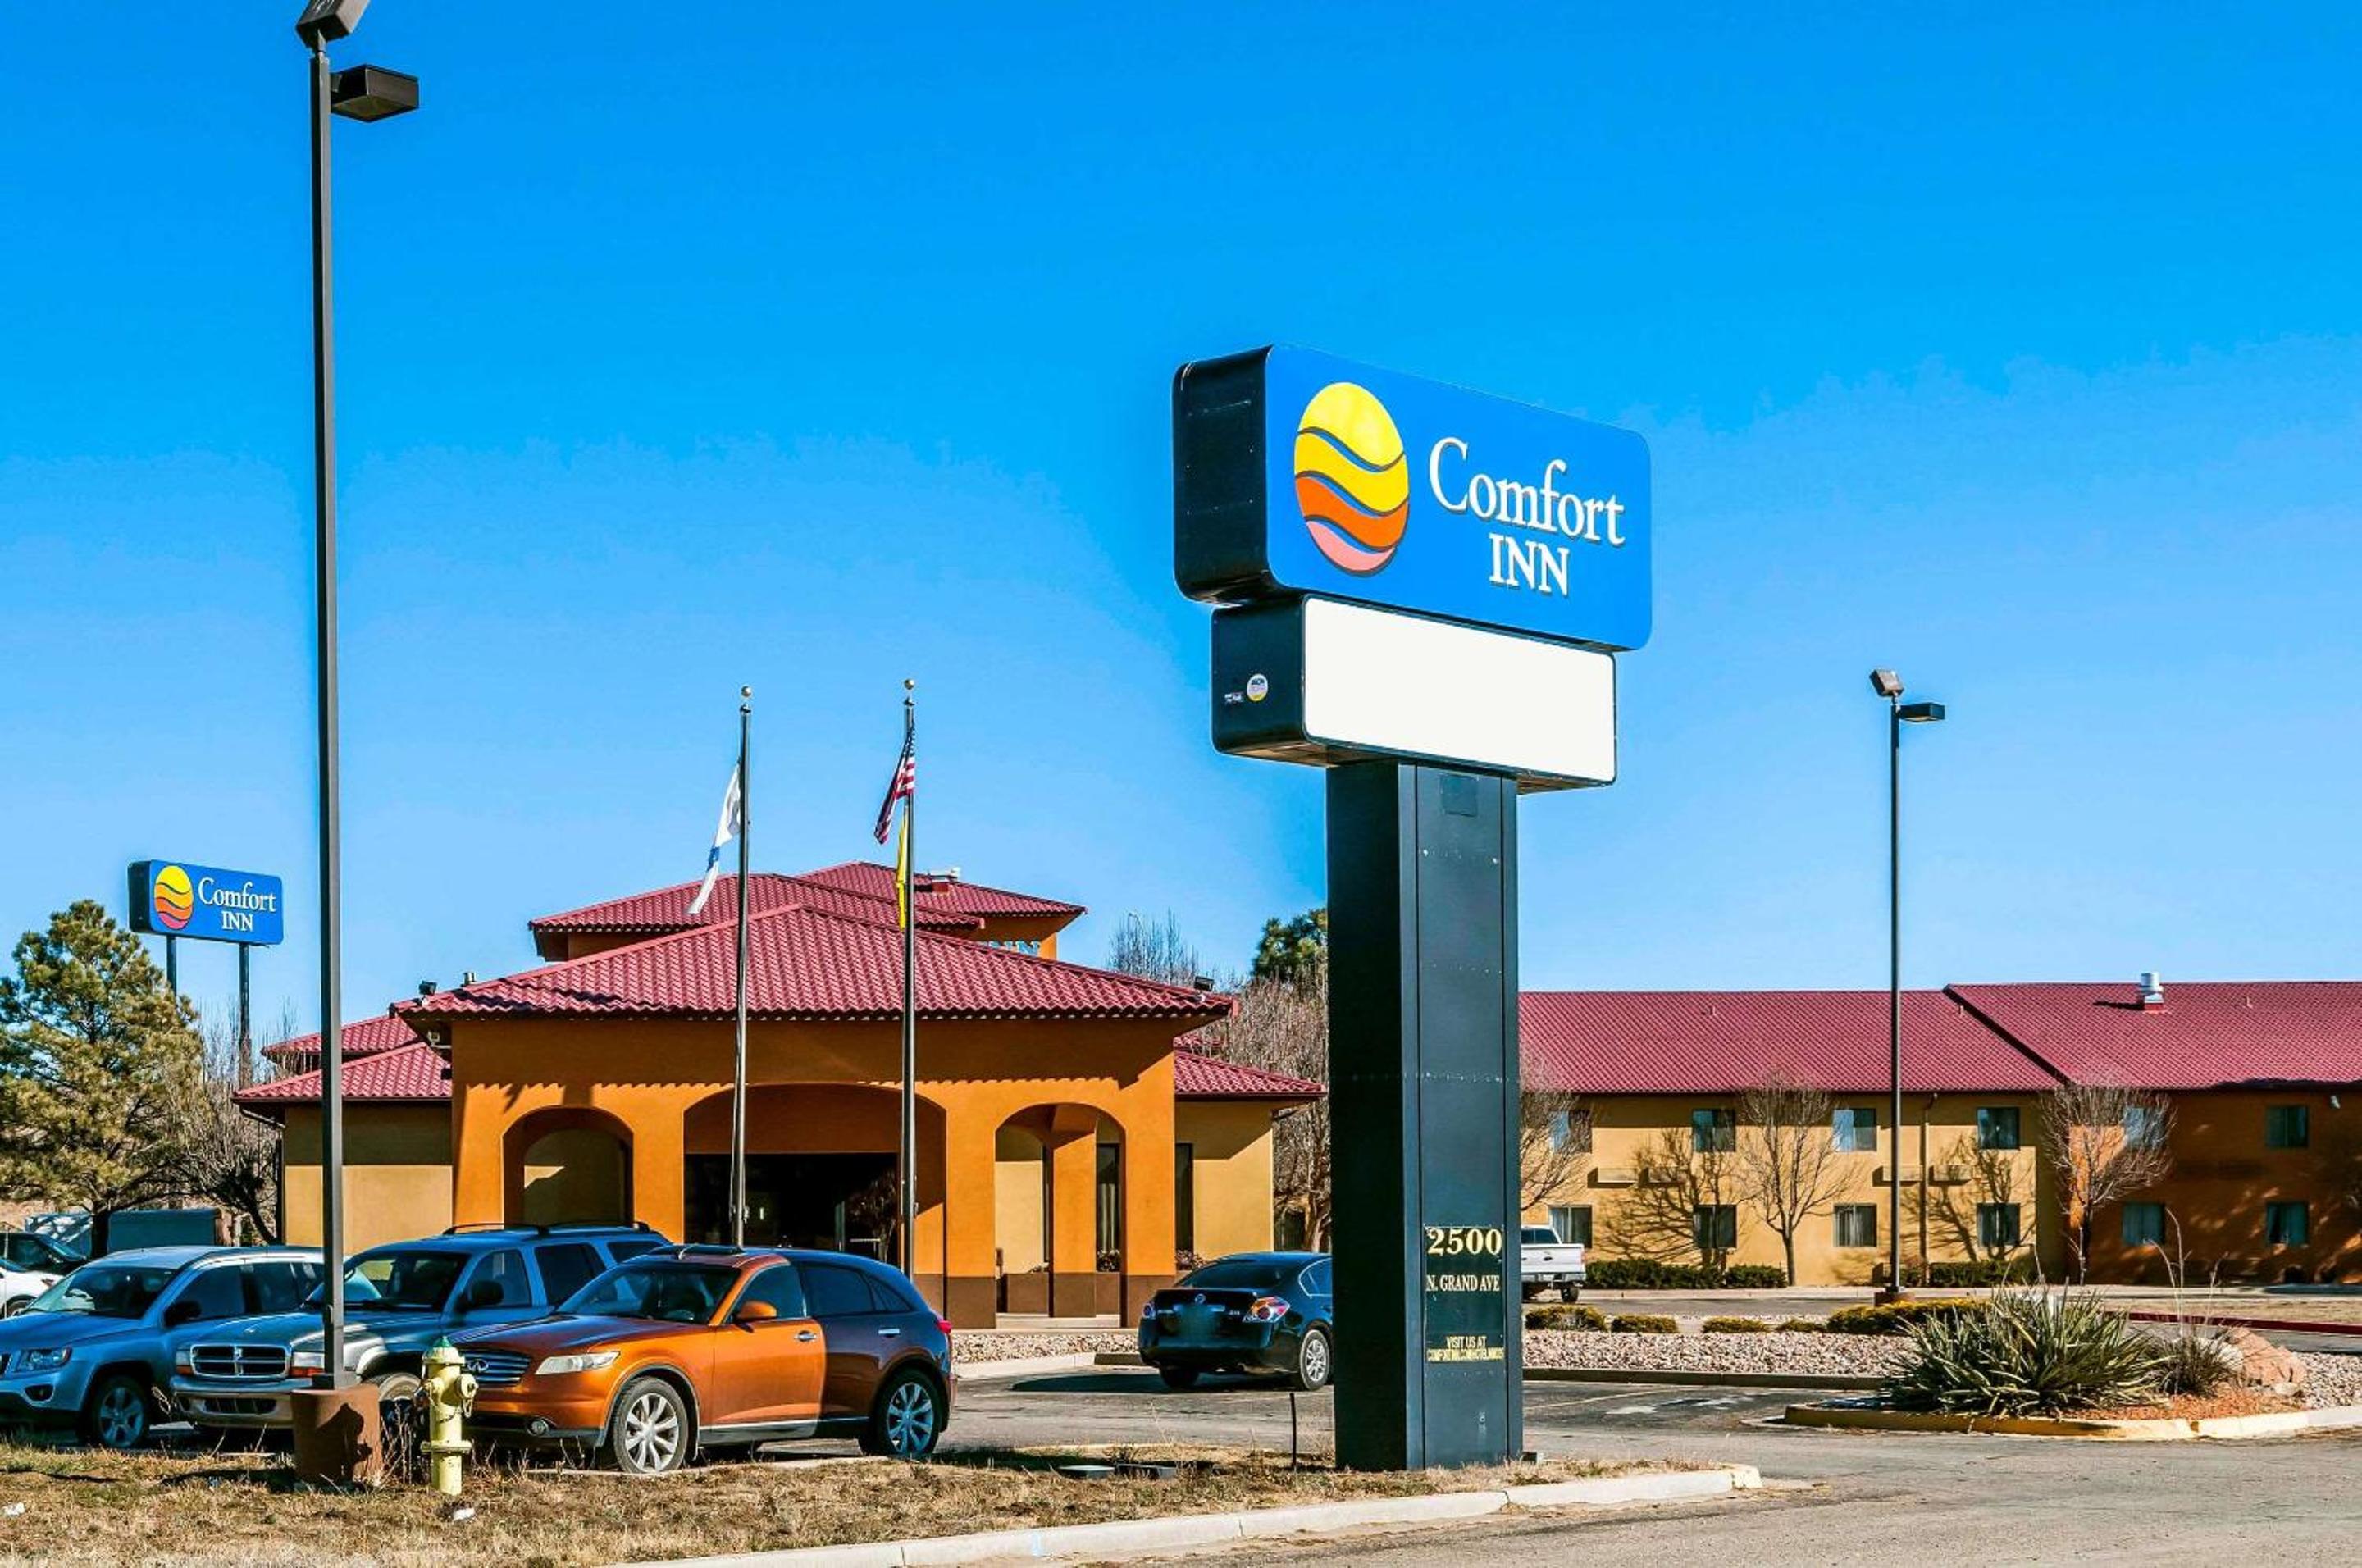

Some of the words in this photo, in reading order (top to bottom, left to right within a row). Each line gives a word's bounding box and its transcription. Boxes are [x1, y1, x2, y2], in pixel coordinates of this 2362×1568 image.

[1429, 437, 1626, 545] Comfort
[1489, 533, 1570, 595] INN
[198, 877, 277, 912] Comfort
[221, 911, 253, 931] INN
[1427, 1228, 1502, 1256] 2500
[1426, 1274, 1439, 1292] N.
[1439, 1274, 1478, 1292] GRAND
[1480, 1274, 1500, 1292] AVE
[1446, 1336, 1464, 1348] VISIT
[1466, 1336, 1476, 1348] US
[1477, 1336, 1487, 1348] AT
